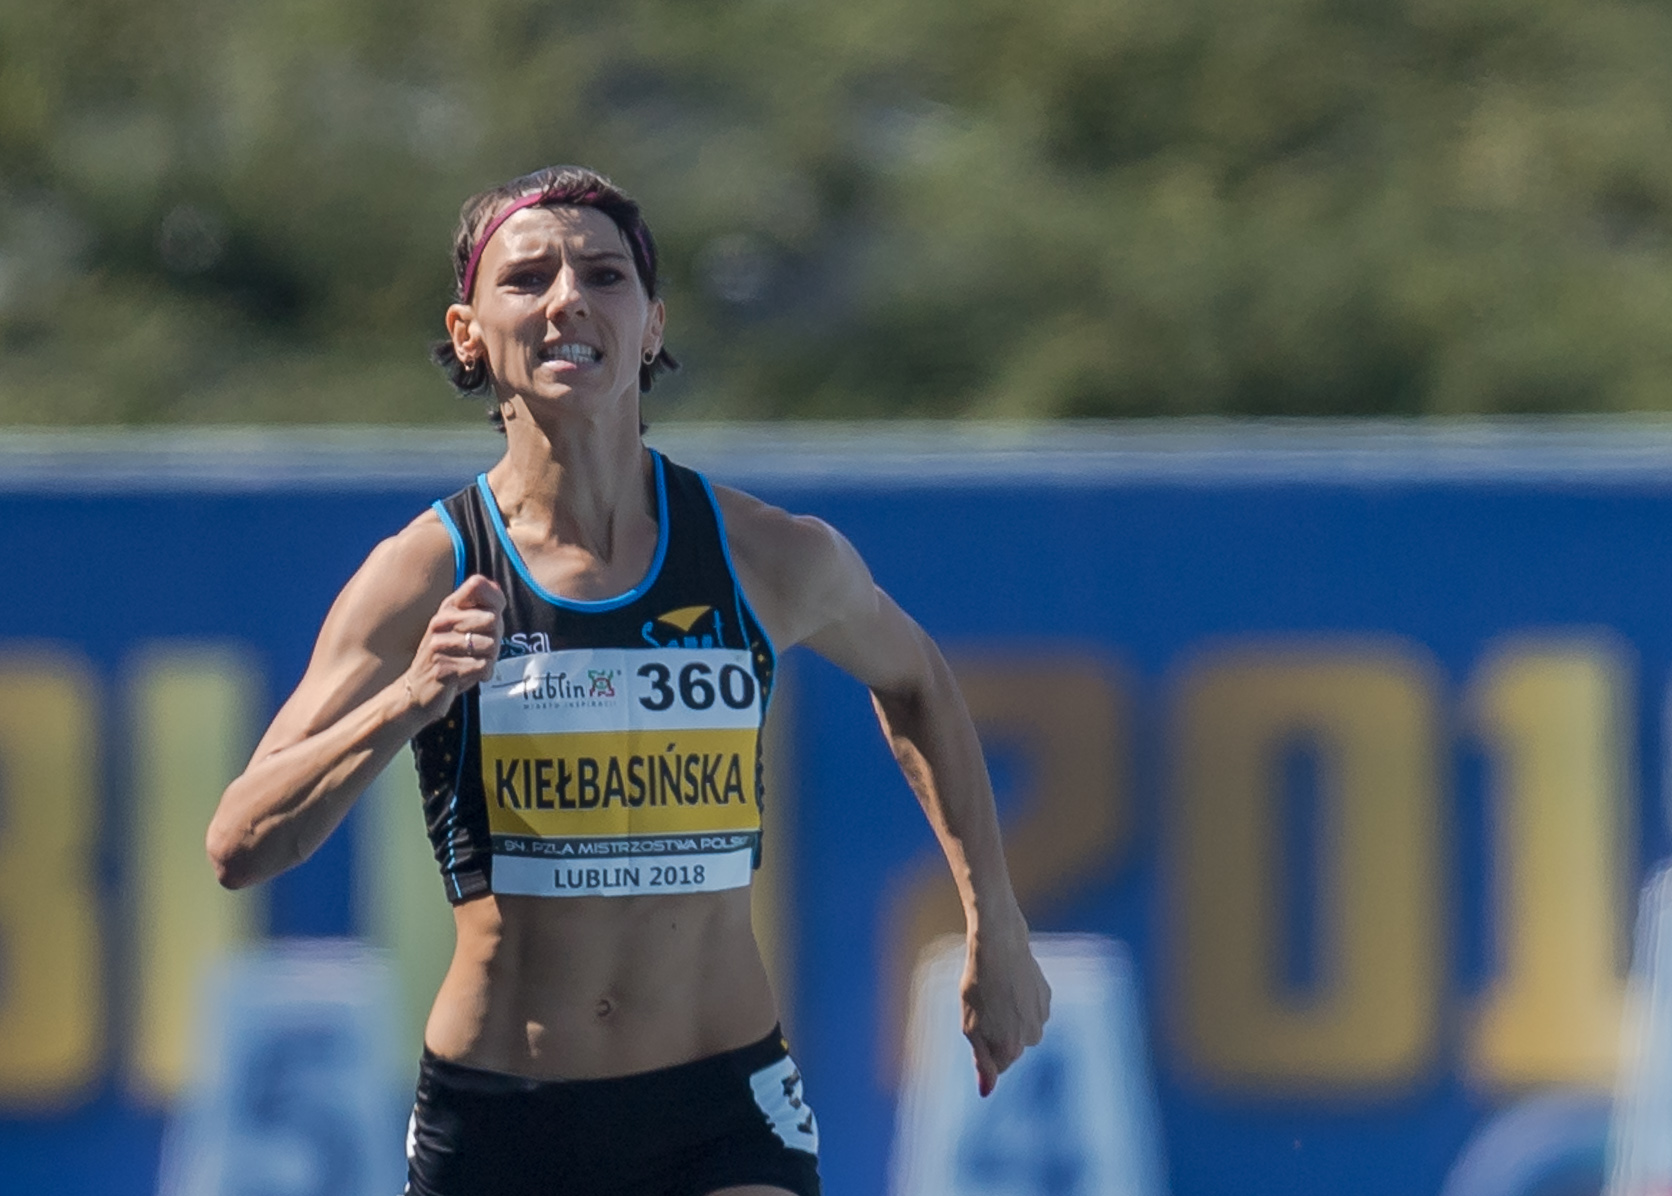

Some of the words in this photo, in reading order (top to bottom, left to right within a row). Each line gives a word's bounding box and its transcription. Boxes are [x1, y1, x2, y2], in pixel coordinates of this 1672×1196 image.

[636, 662, 757, 711] 360
[494, 743, 747, 810] KIEŁBASIŃSKA
[532, 841, 574, 855] PZLA
[577, 838, 698, 855] MISTRZOSTWA
[554, 867, 641, 889] LUBLIN
[649, 864, 705, 886] 2018
